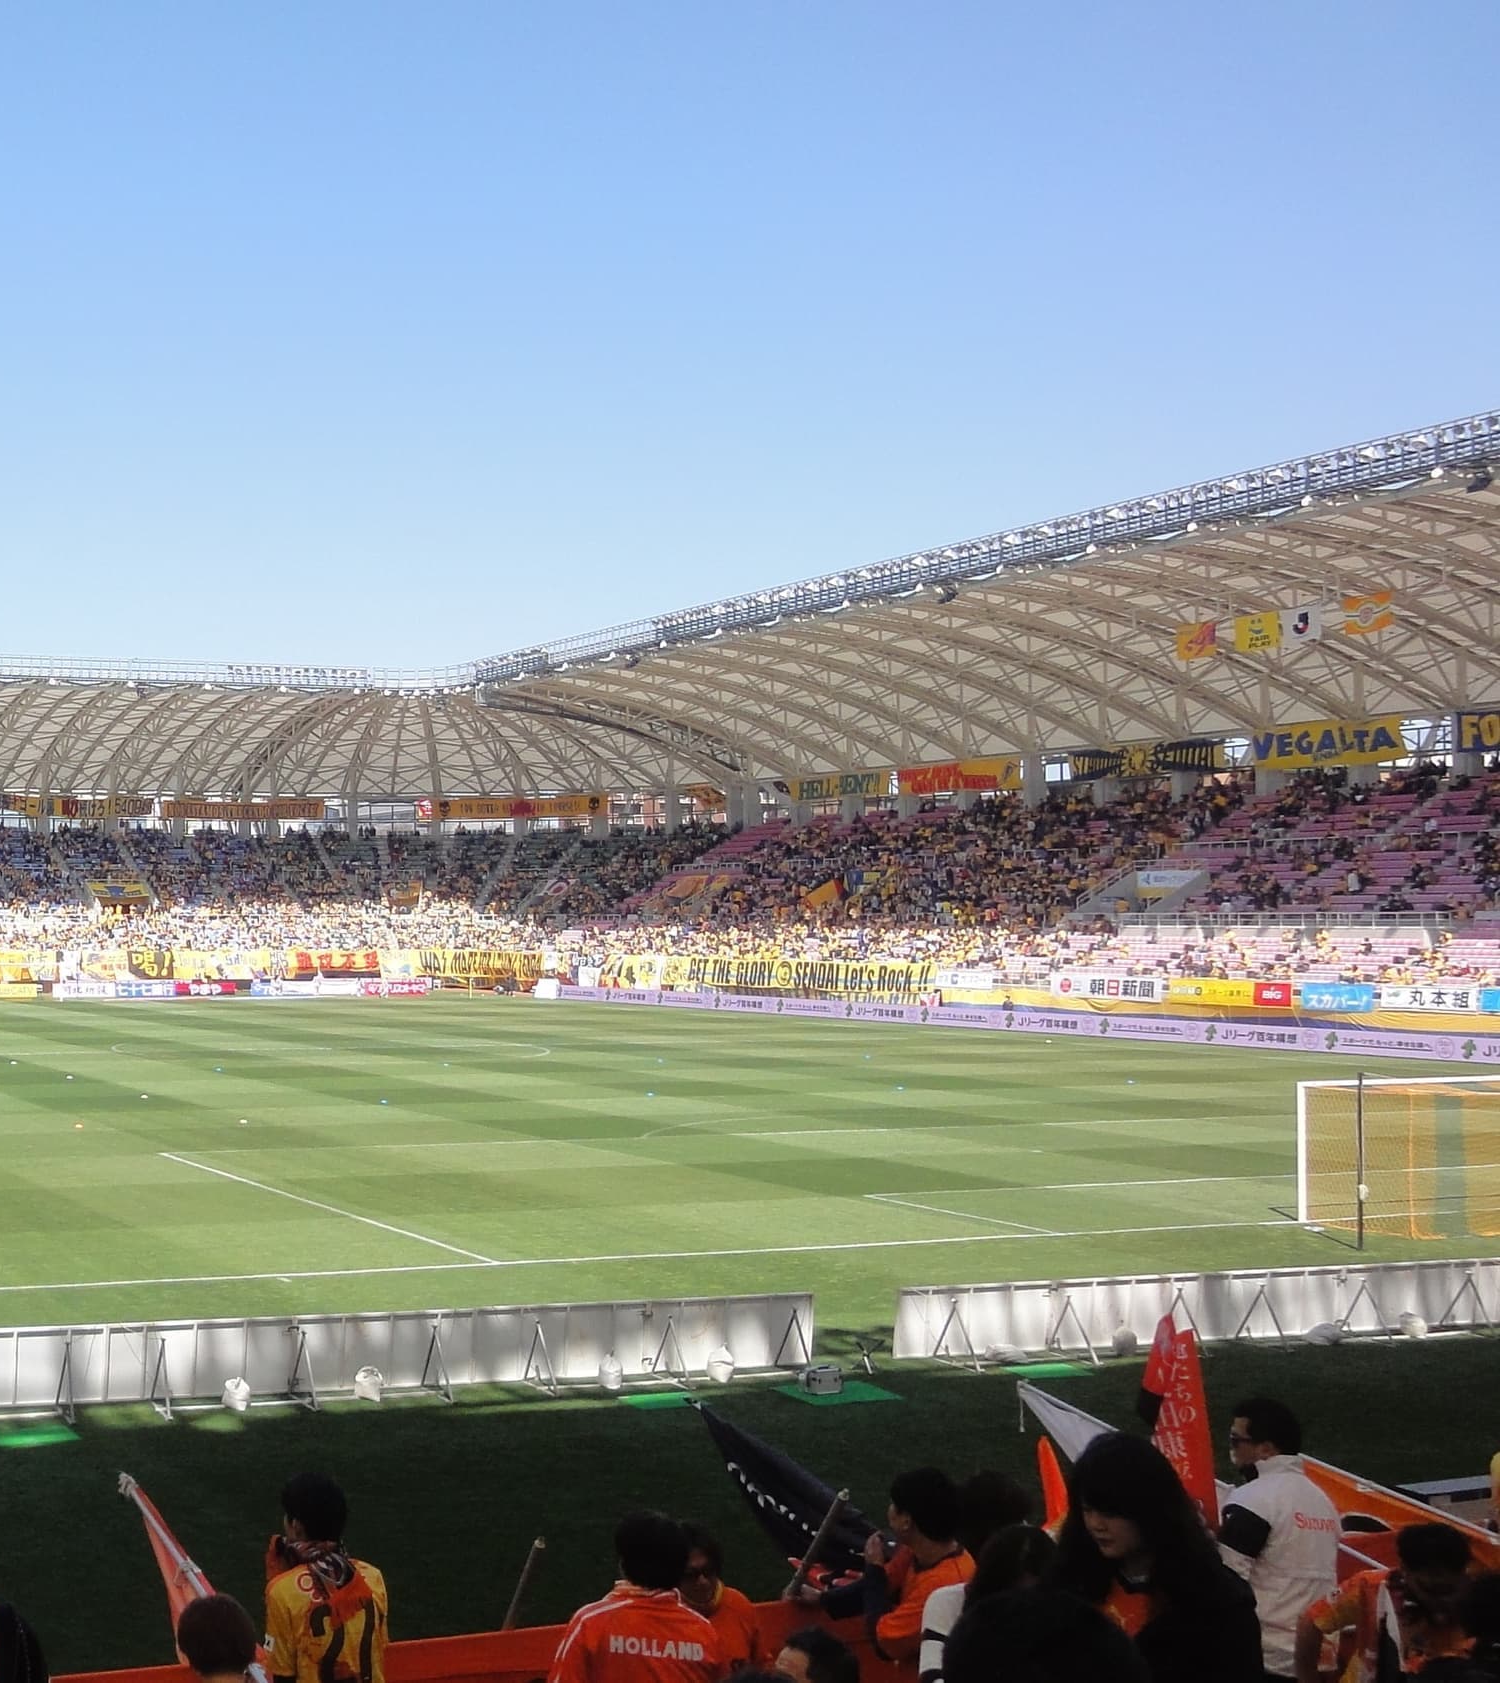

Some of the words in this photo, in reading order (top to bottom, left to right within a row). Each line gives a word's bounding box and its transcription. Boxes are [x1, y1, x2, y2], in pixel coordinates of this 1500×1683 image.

[1252, 726, 1398, 760] VEGALTA
[419, 951, 447, 974] WAS
[688, 957, 710, 982] GET
[711, 958, 733, 985] THE
[735, 959, 775, 987] GLORY
[794, 961, 840, 990] SENDAI
[843, 963, 875, 991] Let's
[877, 965, 914, 992] Rock
[1090, 978, 1155, 999] 朝日新聞
[1261, 987, 1283, 1000] BIG
[1408, 988, 1470, 1009] 丸本組
[1307, 992, 1368, 1010] スカパー!
[855, 1007, 904, 1018] Jリーグ百年構想
[1018, 1017, 1078, 1030] Jリーグ百年構想
[1221, 1028, 1297, 1044] Jリーグ百年構想
[609, 1633, 704, 1661] HOLLAND
